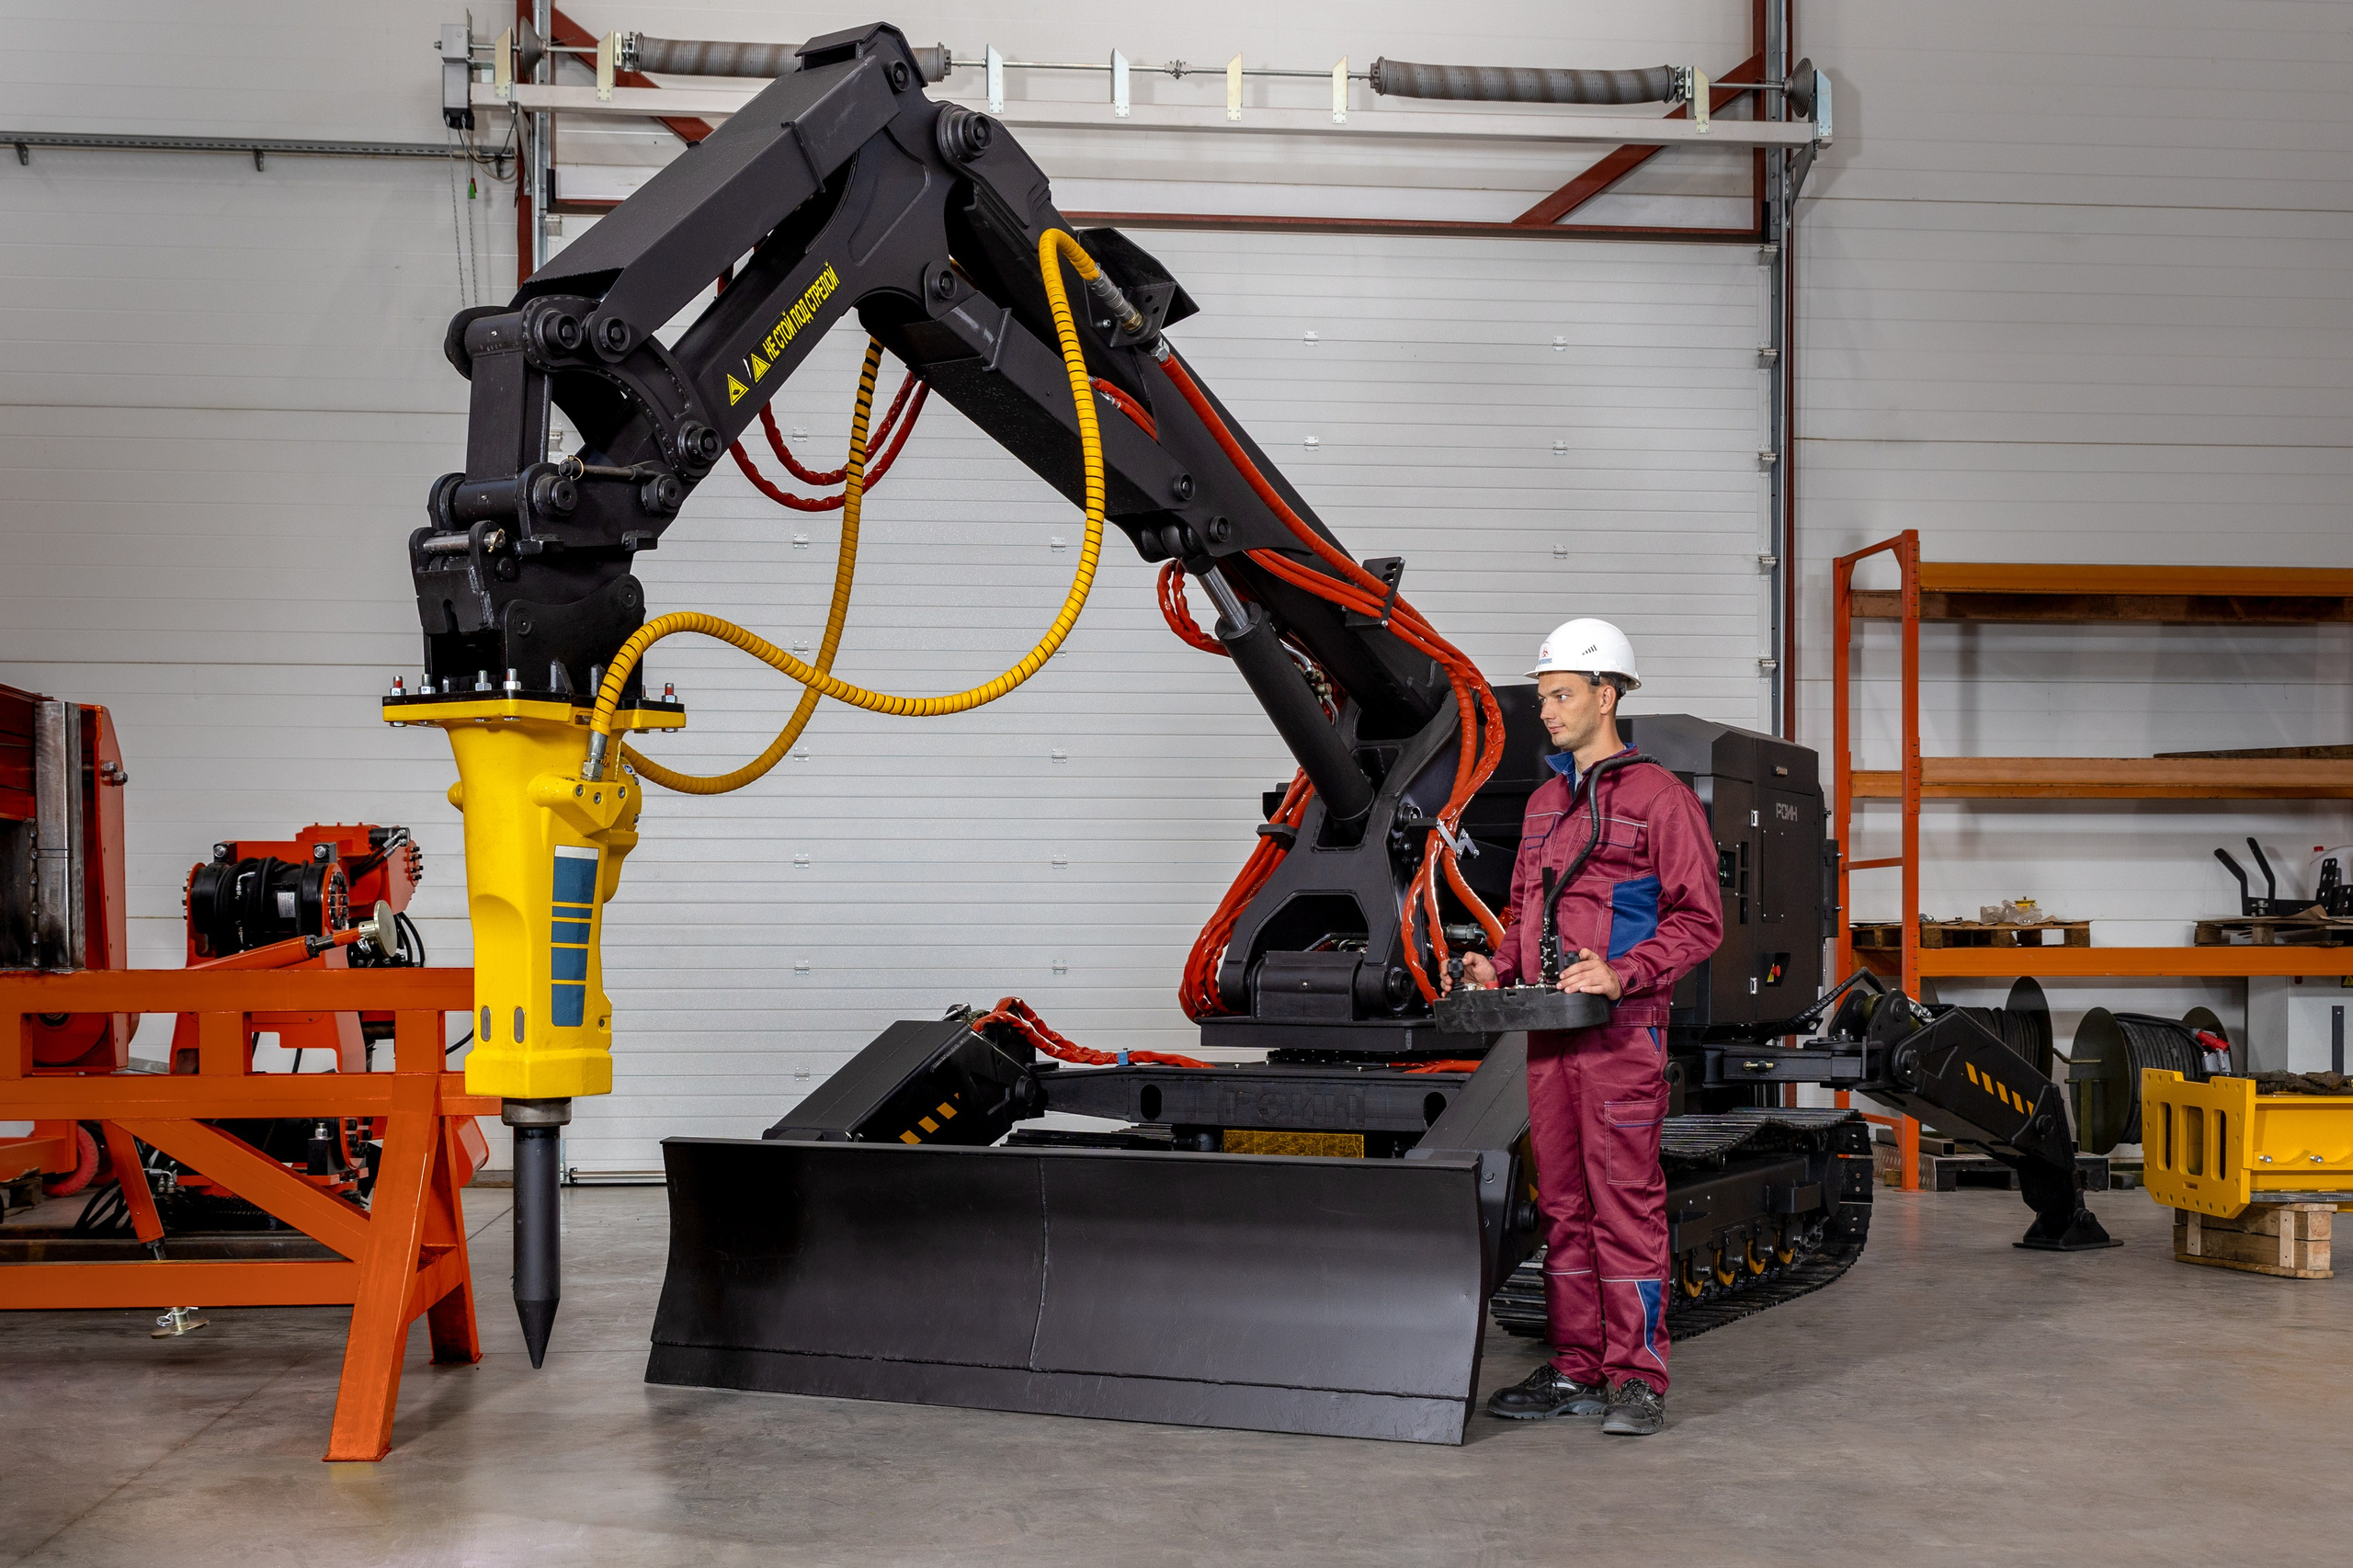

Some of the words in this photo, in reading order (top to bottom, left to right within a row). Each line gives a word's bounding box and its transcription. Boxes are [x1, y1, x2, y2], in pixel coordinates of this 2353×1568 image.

[762, 335, 780, 361] НЕ
[772, 311, 798, 349] СТОЙ
[789, 298, 814, 330] ПОД
[805, 261, 840, 312] СТРЕЛОЙ
